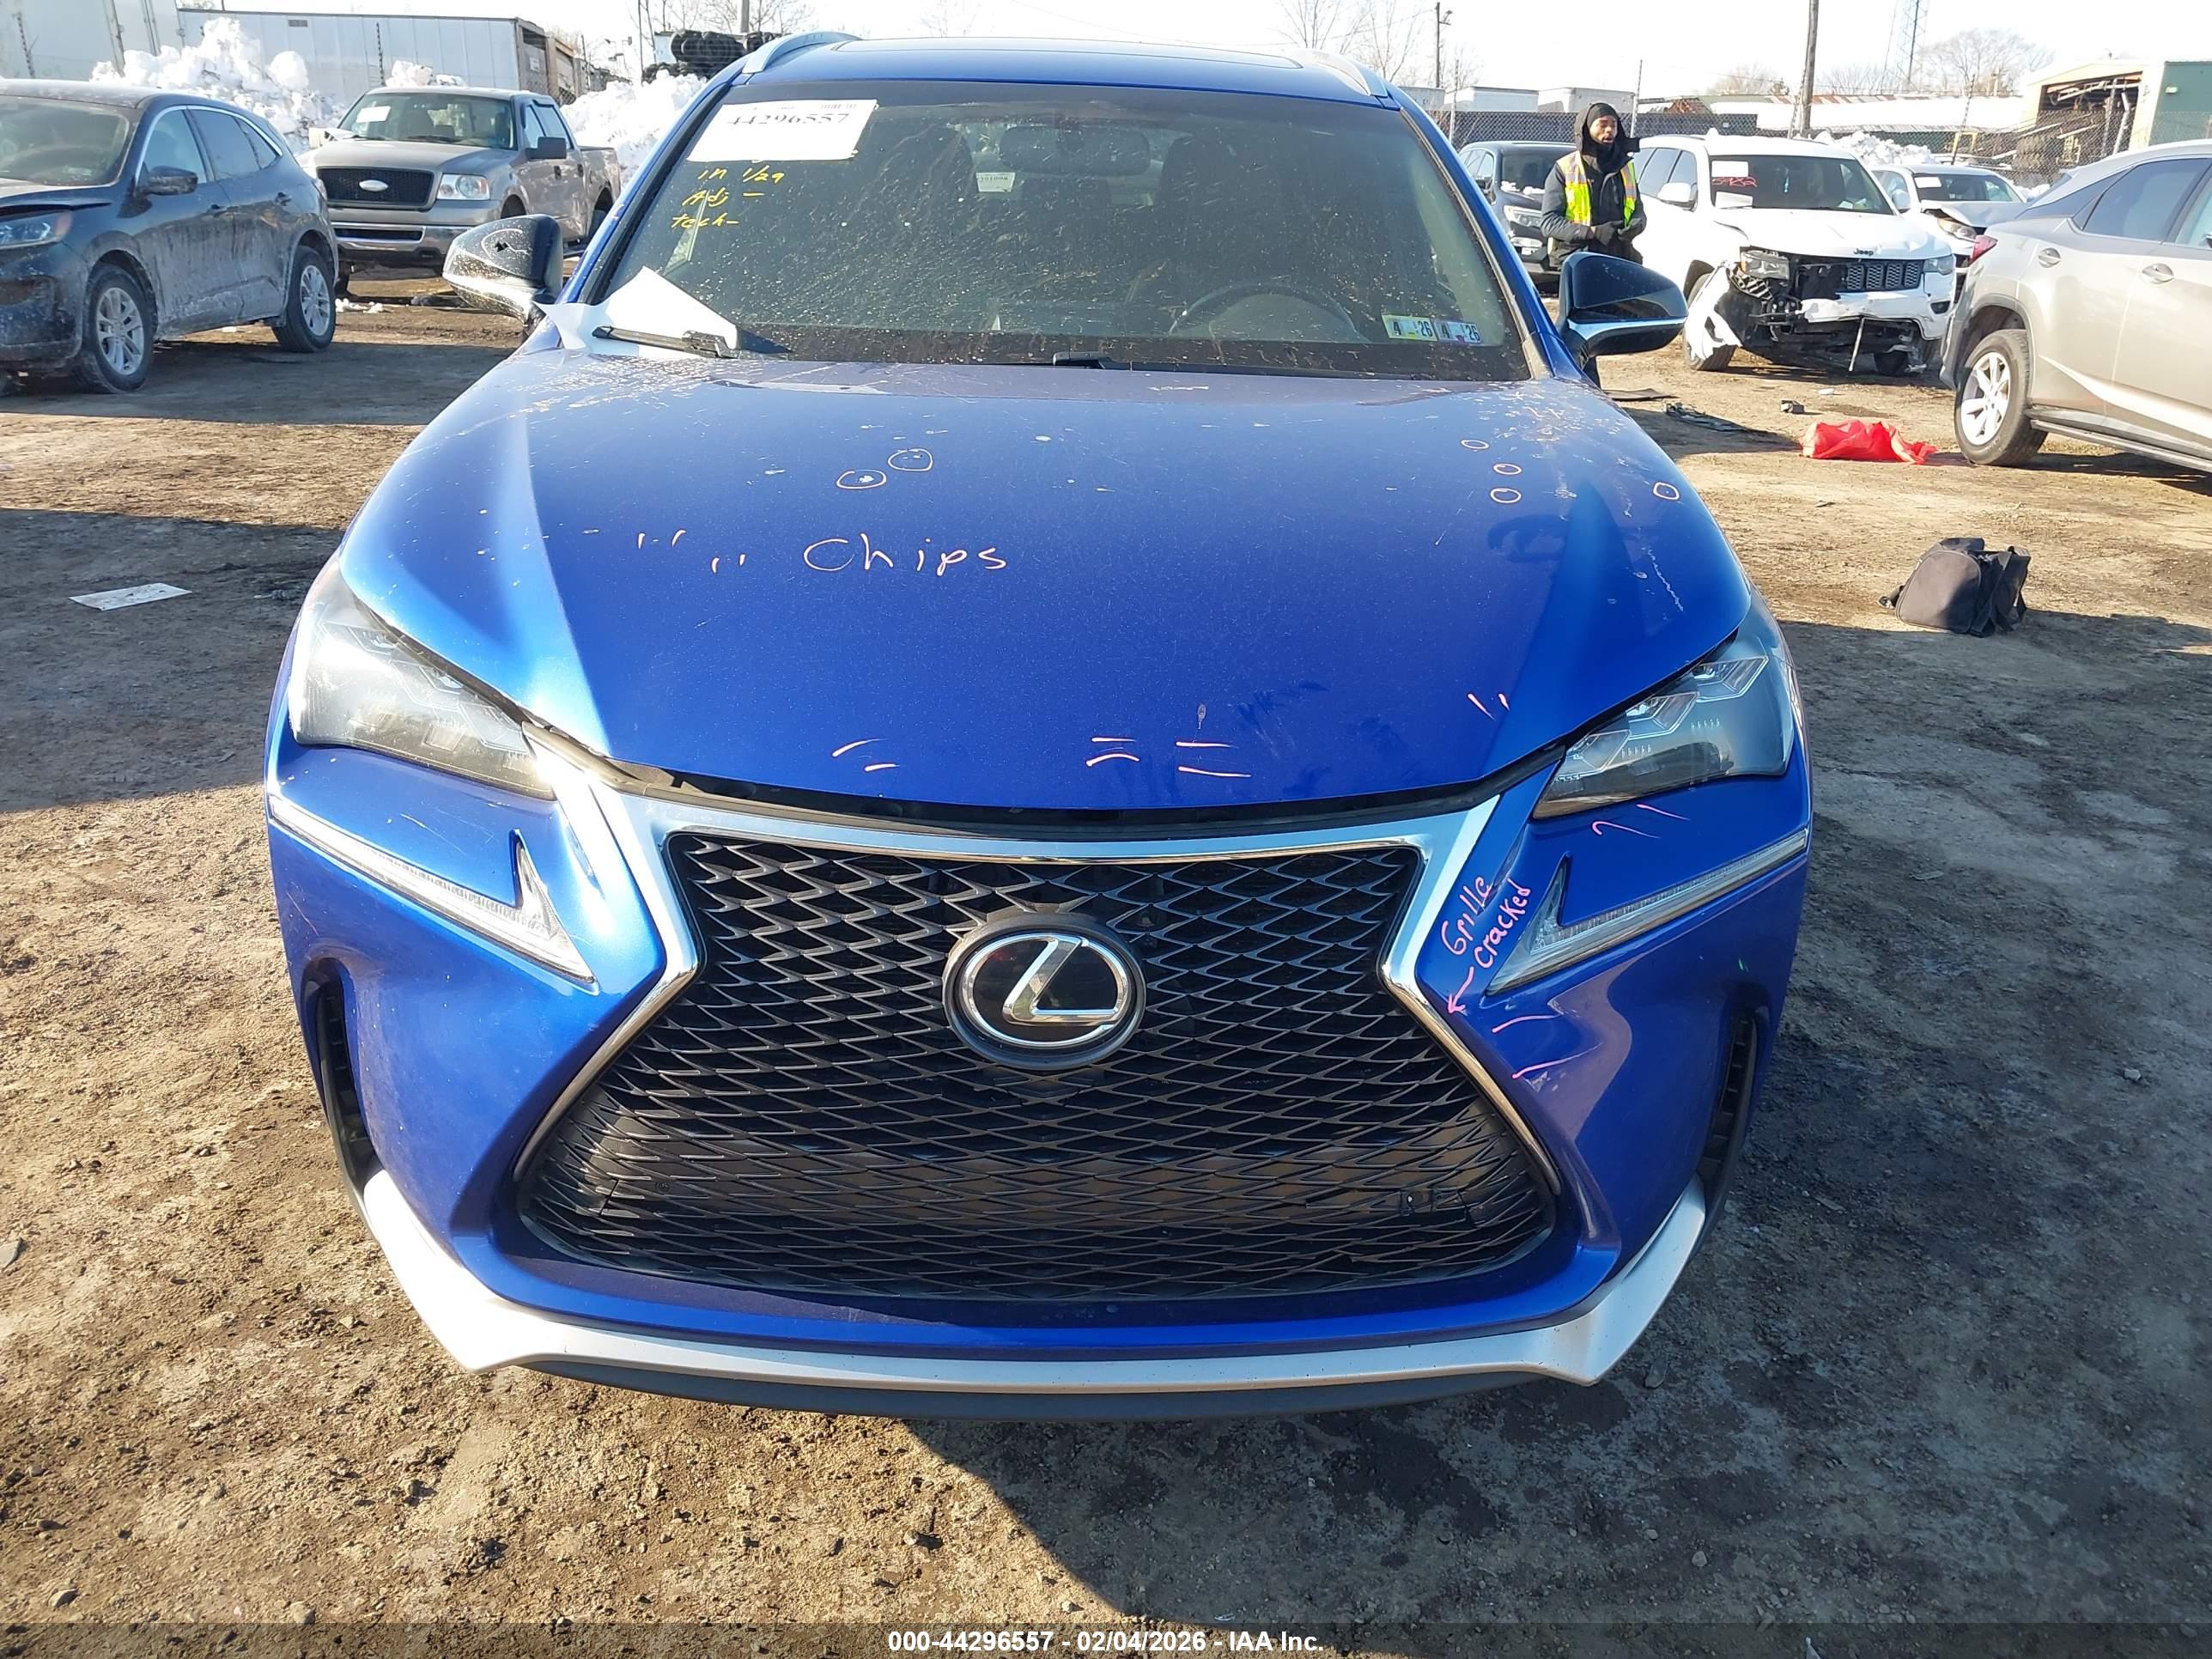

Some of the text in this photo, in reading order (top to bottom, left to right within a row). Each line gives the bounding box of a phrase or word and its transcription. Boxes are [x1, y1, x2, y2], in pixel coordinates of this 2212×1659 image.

[1853, 247, 1875, 257] Jeep
[1418, 320, 1433, 337] 26
[1466, 325, 1481, 342] 26
[803, 532, 1008, 577] Chips
